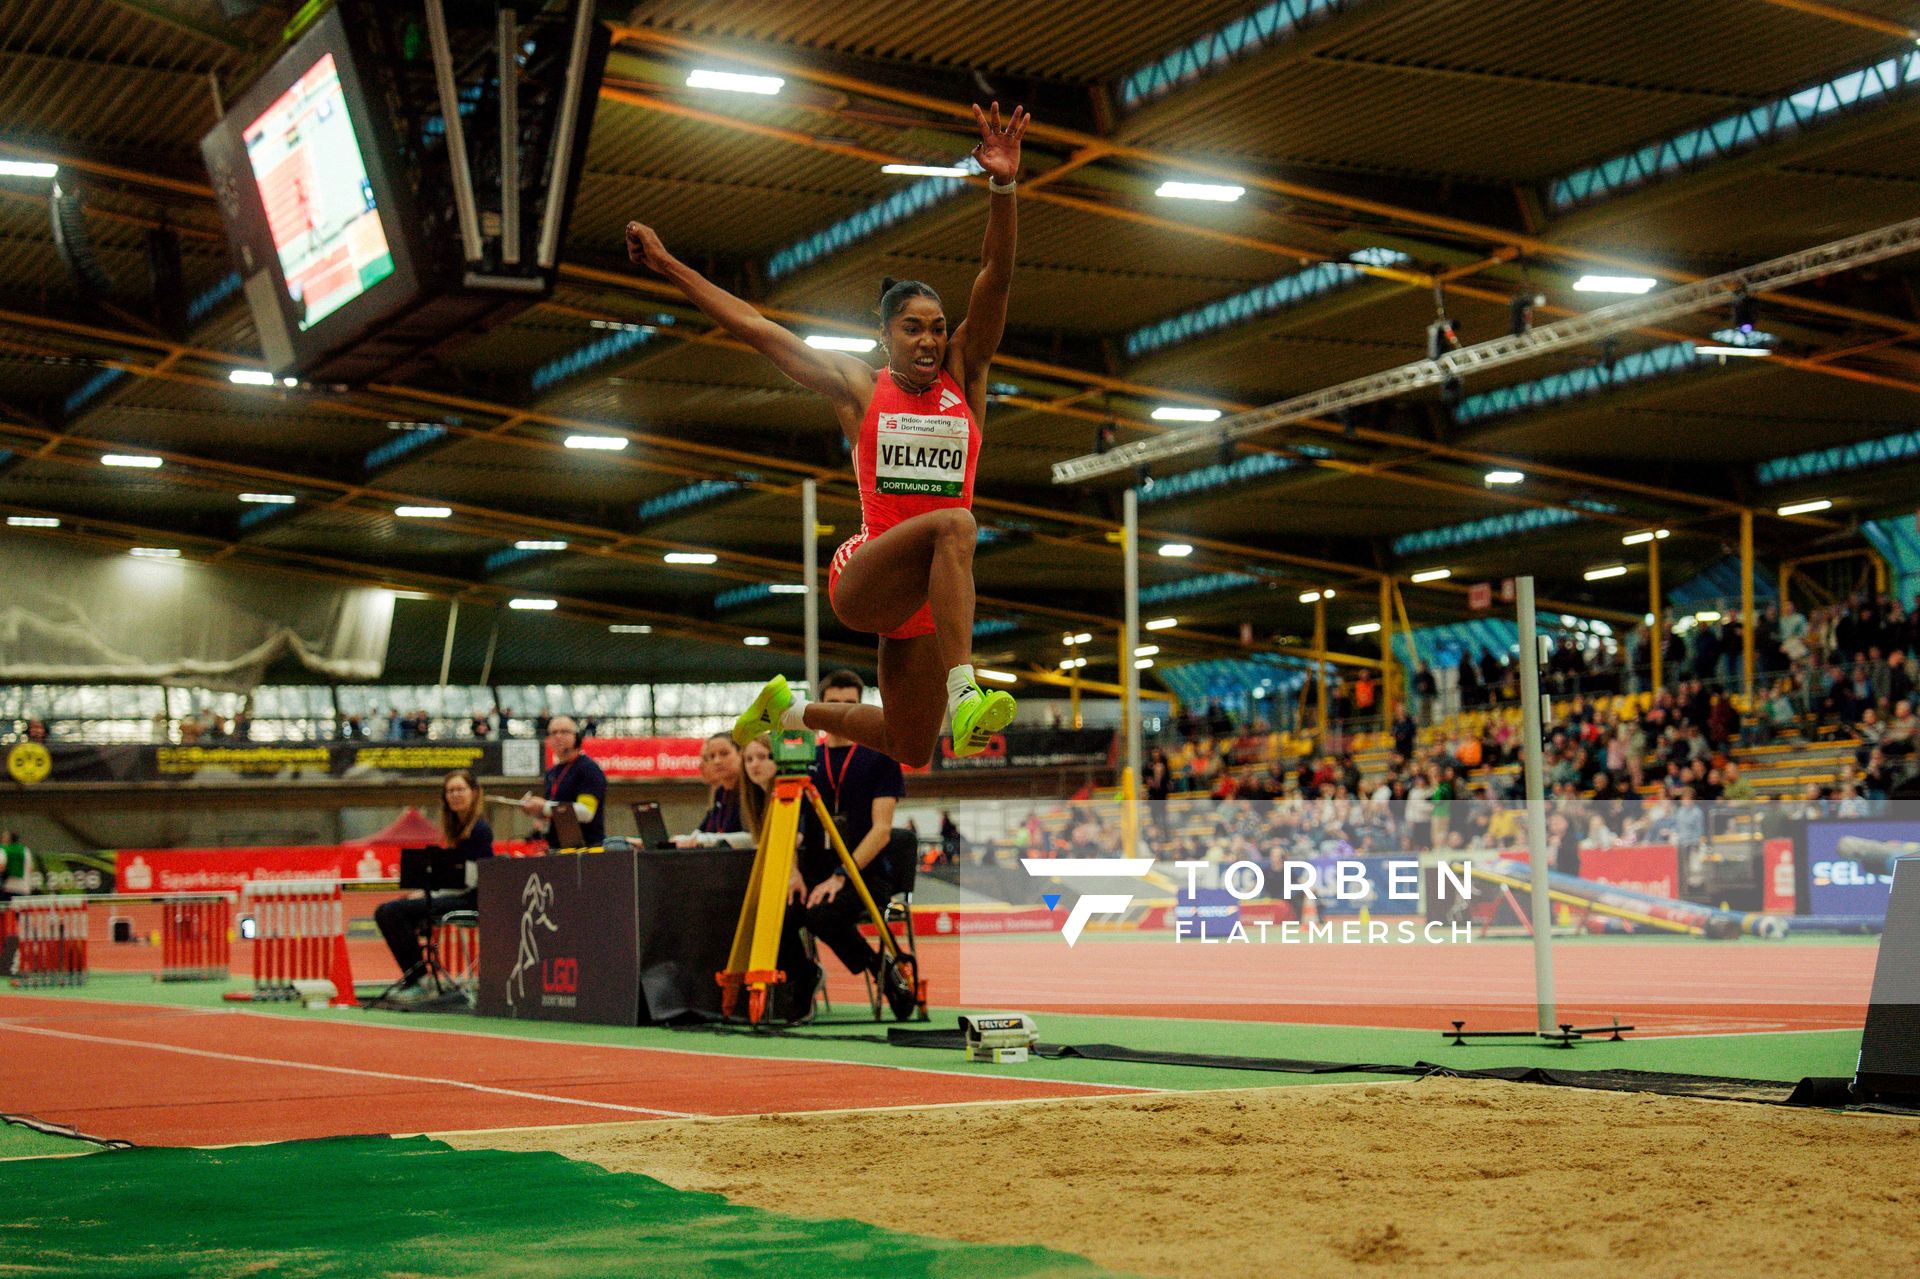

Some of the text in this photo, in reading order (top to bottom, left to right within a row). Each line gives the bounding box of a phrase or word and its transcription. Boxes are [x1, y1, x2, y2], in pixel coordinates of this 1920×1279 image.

[901, 424, 935, 432] Dortmund
[882, 444, 963, 470] VELAZCO
[883, 481, 942, 492] DORTMUND 26
[979, 1019, 1009, 1029] SELTEC
